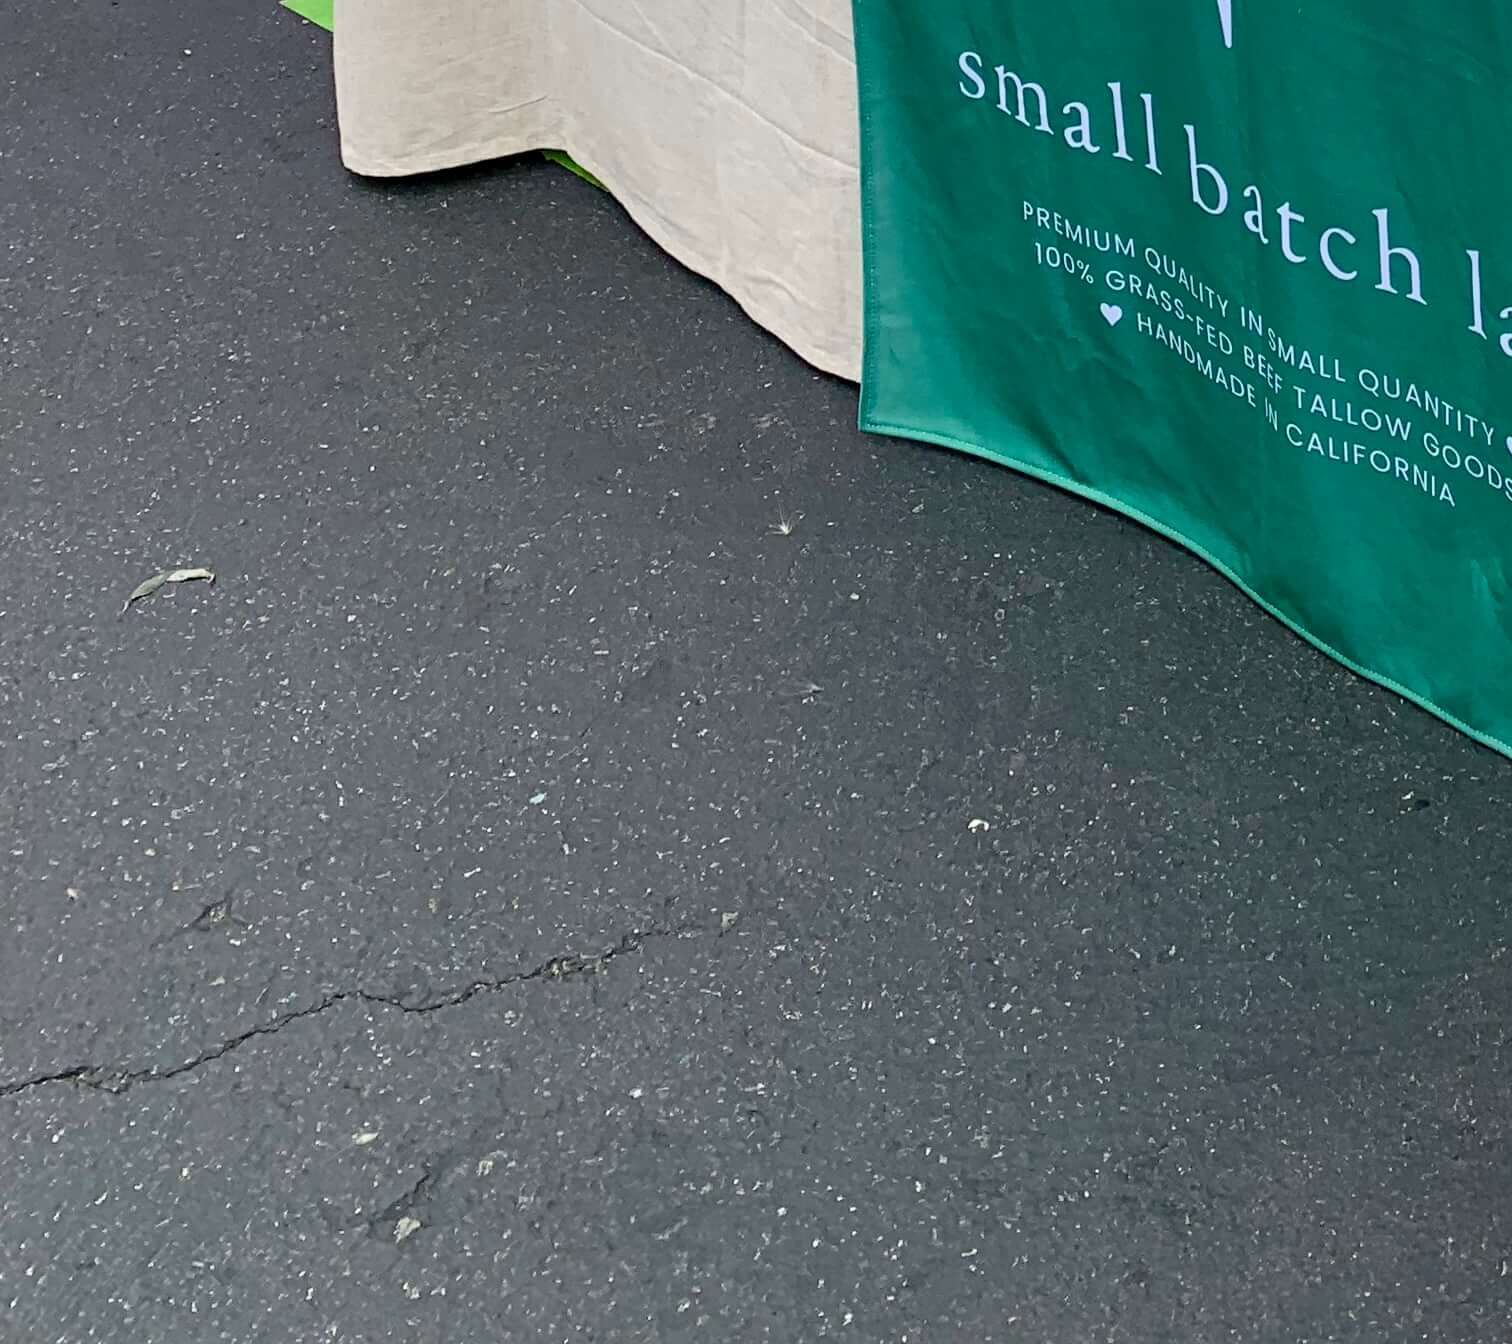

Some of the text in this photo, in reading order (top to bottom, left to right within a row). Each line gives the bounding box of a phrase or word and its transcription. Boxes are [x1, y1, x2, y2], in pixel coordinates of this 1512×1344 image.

[959, 51, 1162, 175] small
[1184, 124, 1427, 305] batch
[1024, 200, 1494, 446] PREMIUM QUALITY IN SMALL QUANTITY
[1035, 242, 1094, 284] 100%
[1106, 270, 1233, 354] GRASS-FED
[1243, 345, 1282, 393] BEEF
[1293, 385, 1411, 440] TALLOW
[1137, 312, 1455, 507] HANDMADE IN CALIFORNIA
